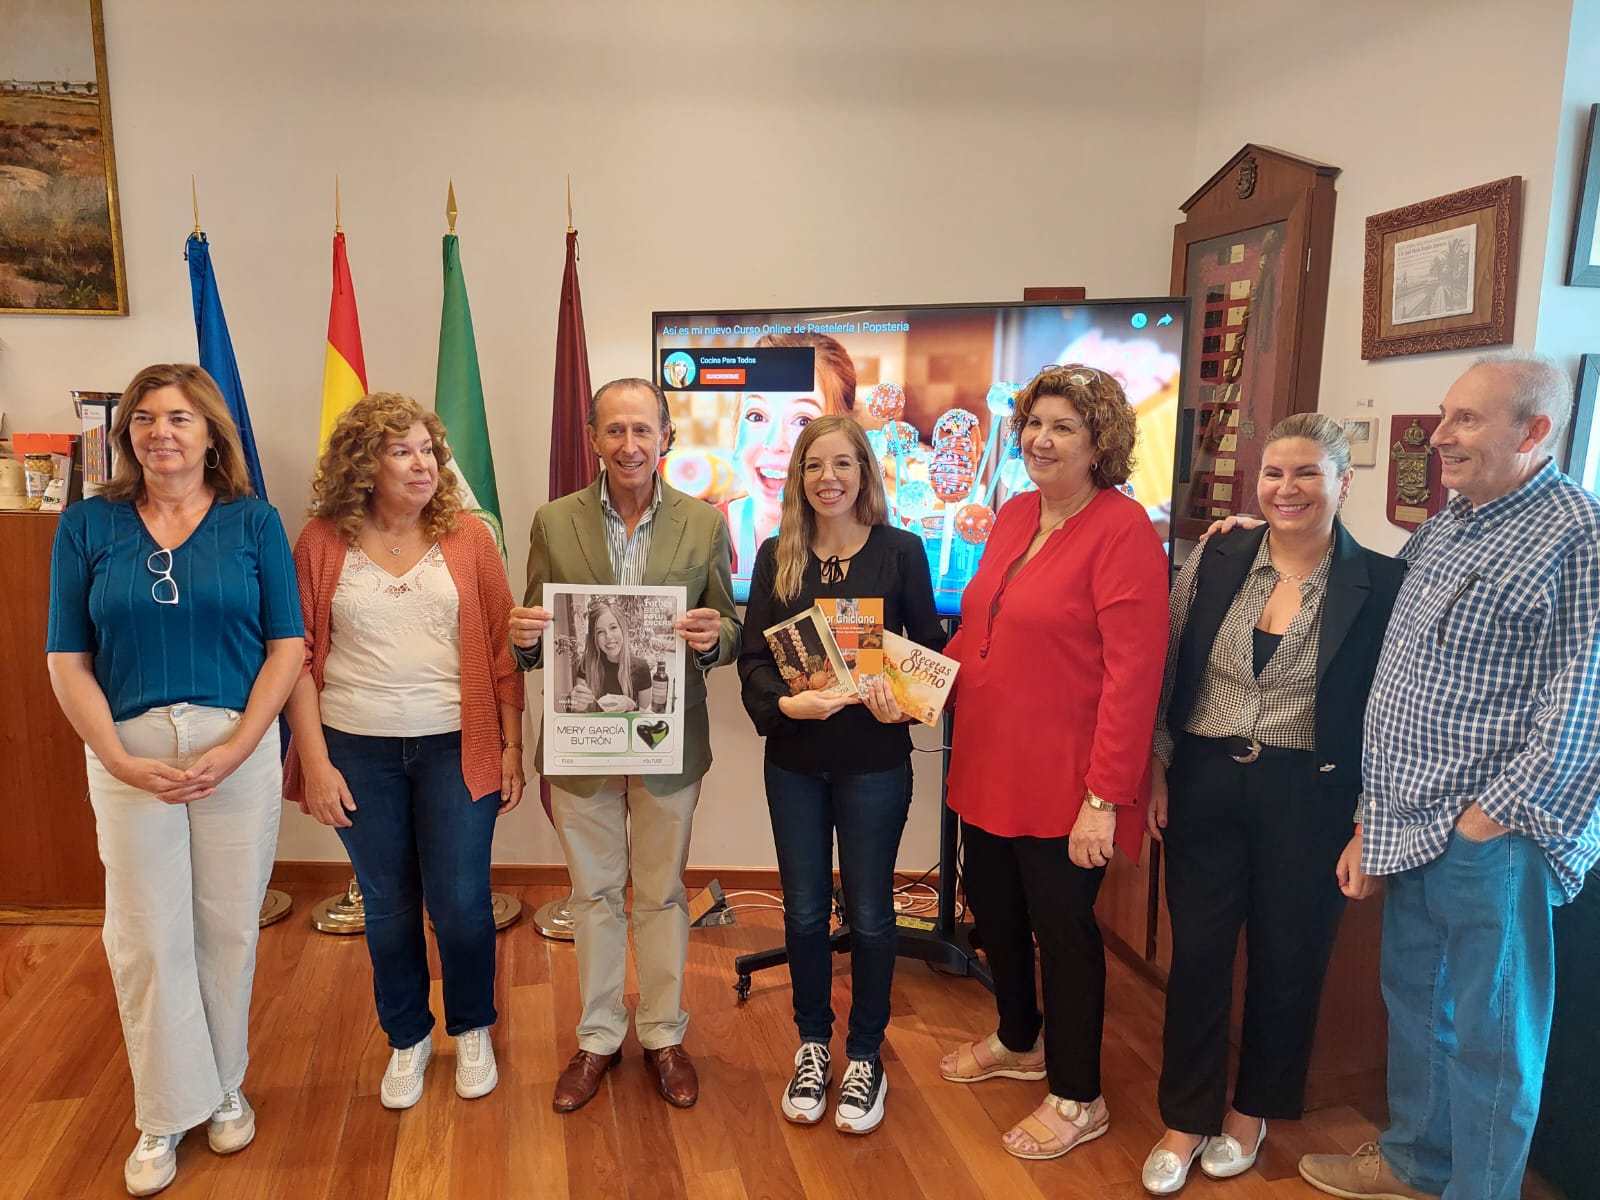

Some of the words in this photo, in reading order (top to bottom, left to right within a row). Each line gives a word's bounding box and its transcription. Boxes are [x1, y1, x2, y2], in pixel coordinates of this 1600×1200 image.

[678, 327, 688, 336] es
[691, 325, 702, 335] mi
[704, 326, 731, 335] nuevo
[733, 324, 760, 335] Curso
[762, 323, 792, 334] Online
[794, 323, 806, 334] de
[700, 356, 720, 364] Cocina
[721, 356, 737, 364] Para
[738, 355, 757, 364] Todos
[910, 648, 952, 676] Recetas
[900, 658, 946, 689] Otoño
[557, 725, 585, 735] MERY
[588, 723, 625, 735] GARCÍA
[571, 735, 612, 746] BUTRÓN
